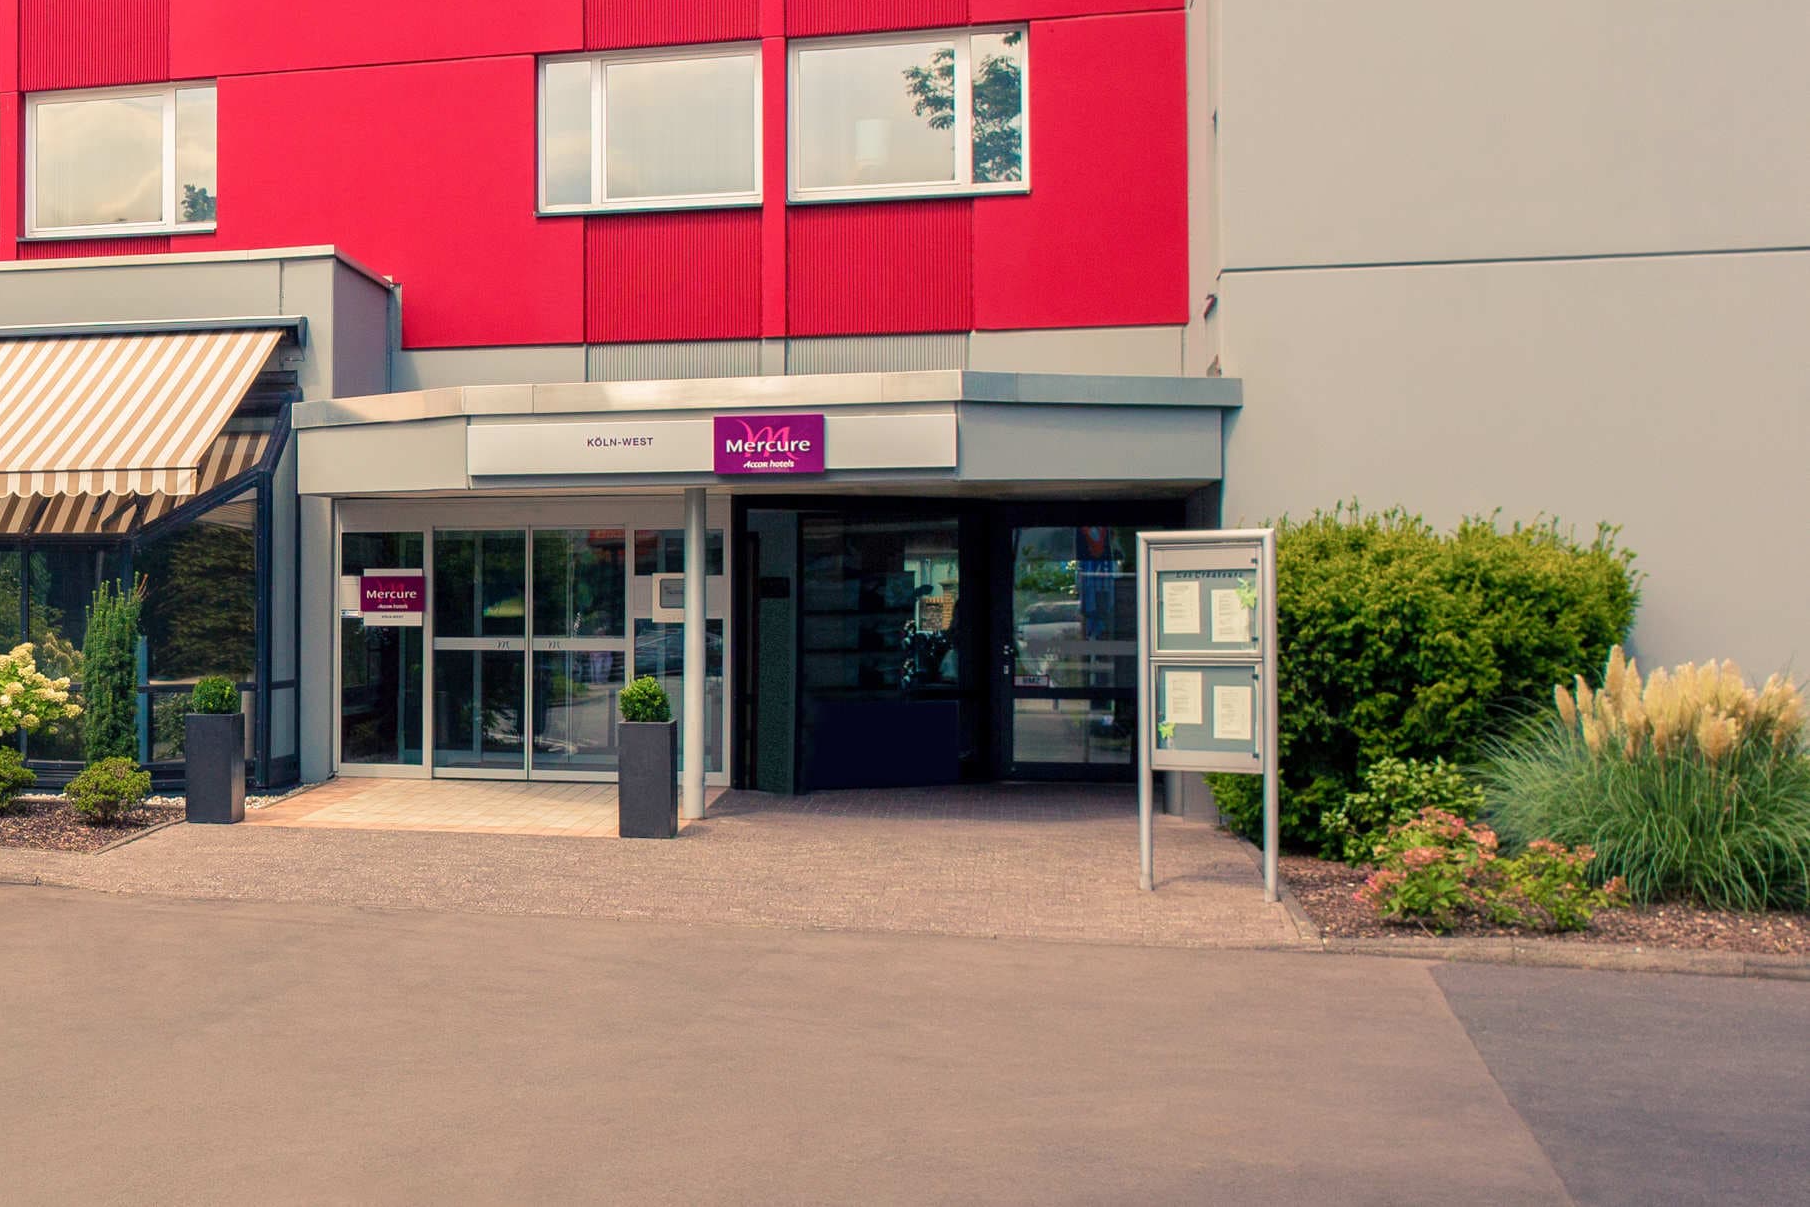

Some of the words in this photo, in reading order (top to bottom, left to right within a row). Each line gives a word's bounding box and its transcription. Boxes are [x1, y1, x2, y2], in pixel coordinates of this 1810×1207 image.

[586, 437, 654, 448] KÖLN-WEST
[725, 439, 811, 453] Mercure
[769, 459, 795, 468] hotels
[366, 590, 418, 599] Mercure
